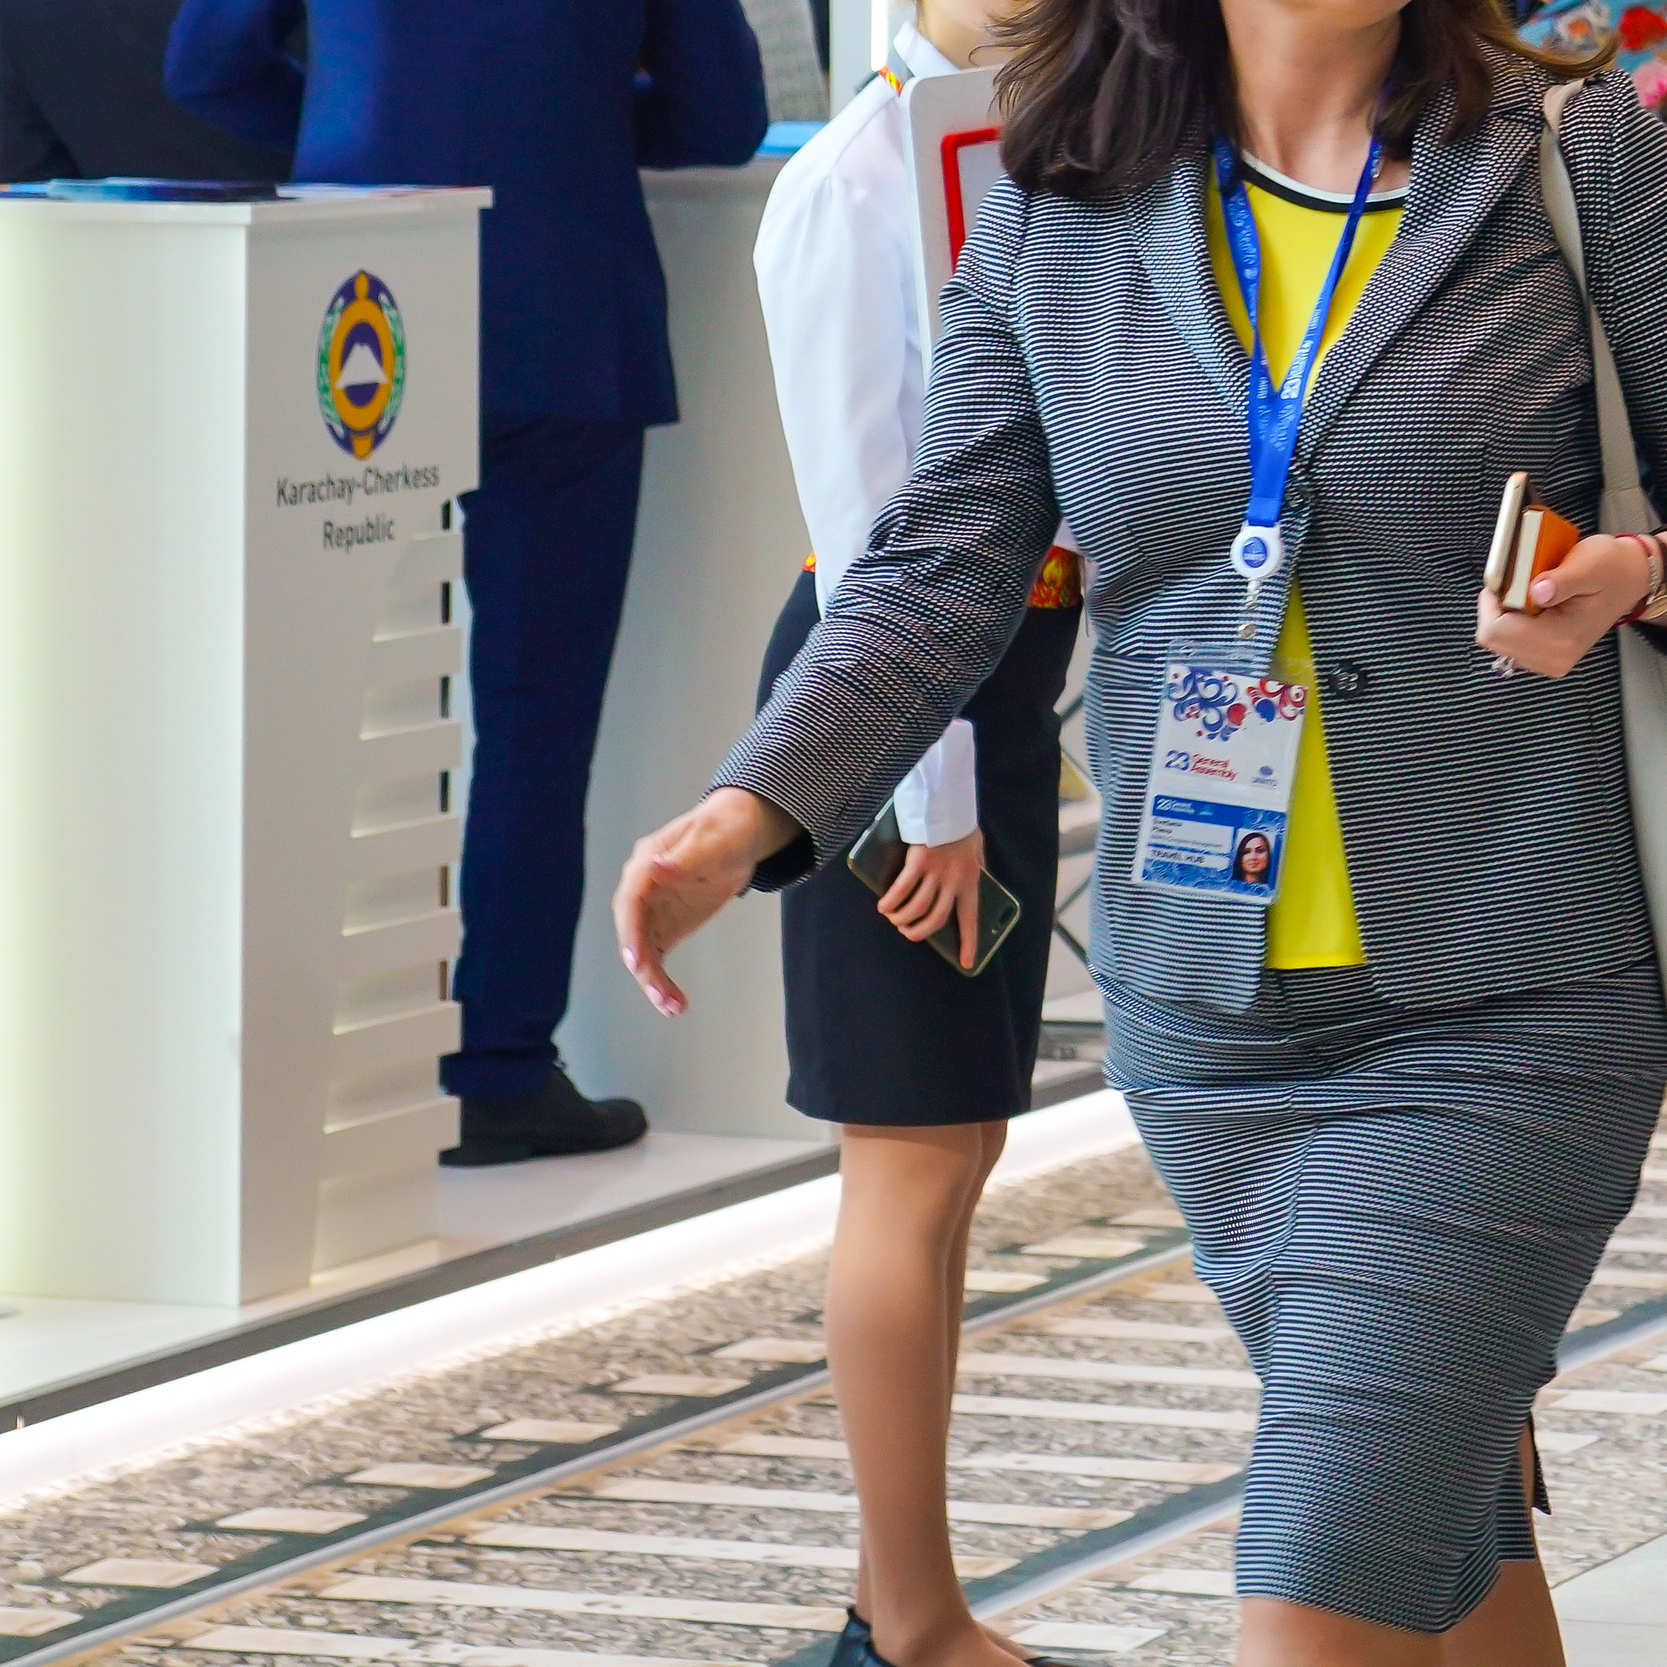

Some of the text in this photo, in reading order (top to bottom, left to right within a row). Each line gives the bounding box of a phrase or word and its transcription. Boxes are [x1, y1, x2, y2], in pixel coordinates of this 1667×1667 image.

[276, 463, 441, 508] Karachay-Cherkess
[323, 514, 396, 553] Republic
[1164, 749, 1190, 771] 23
